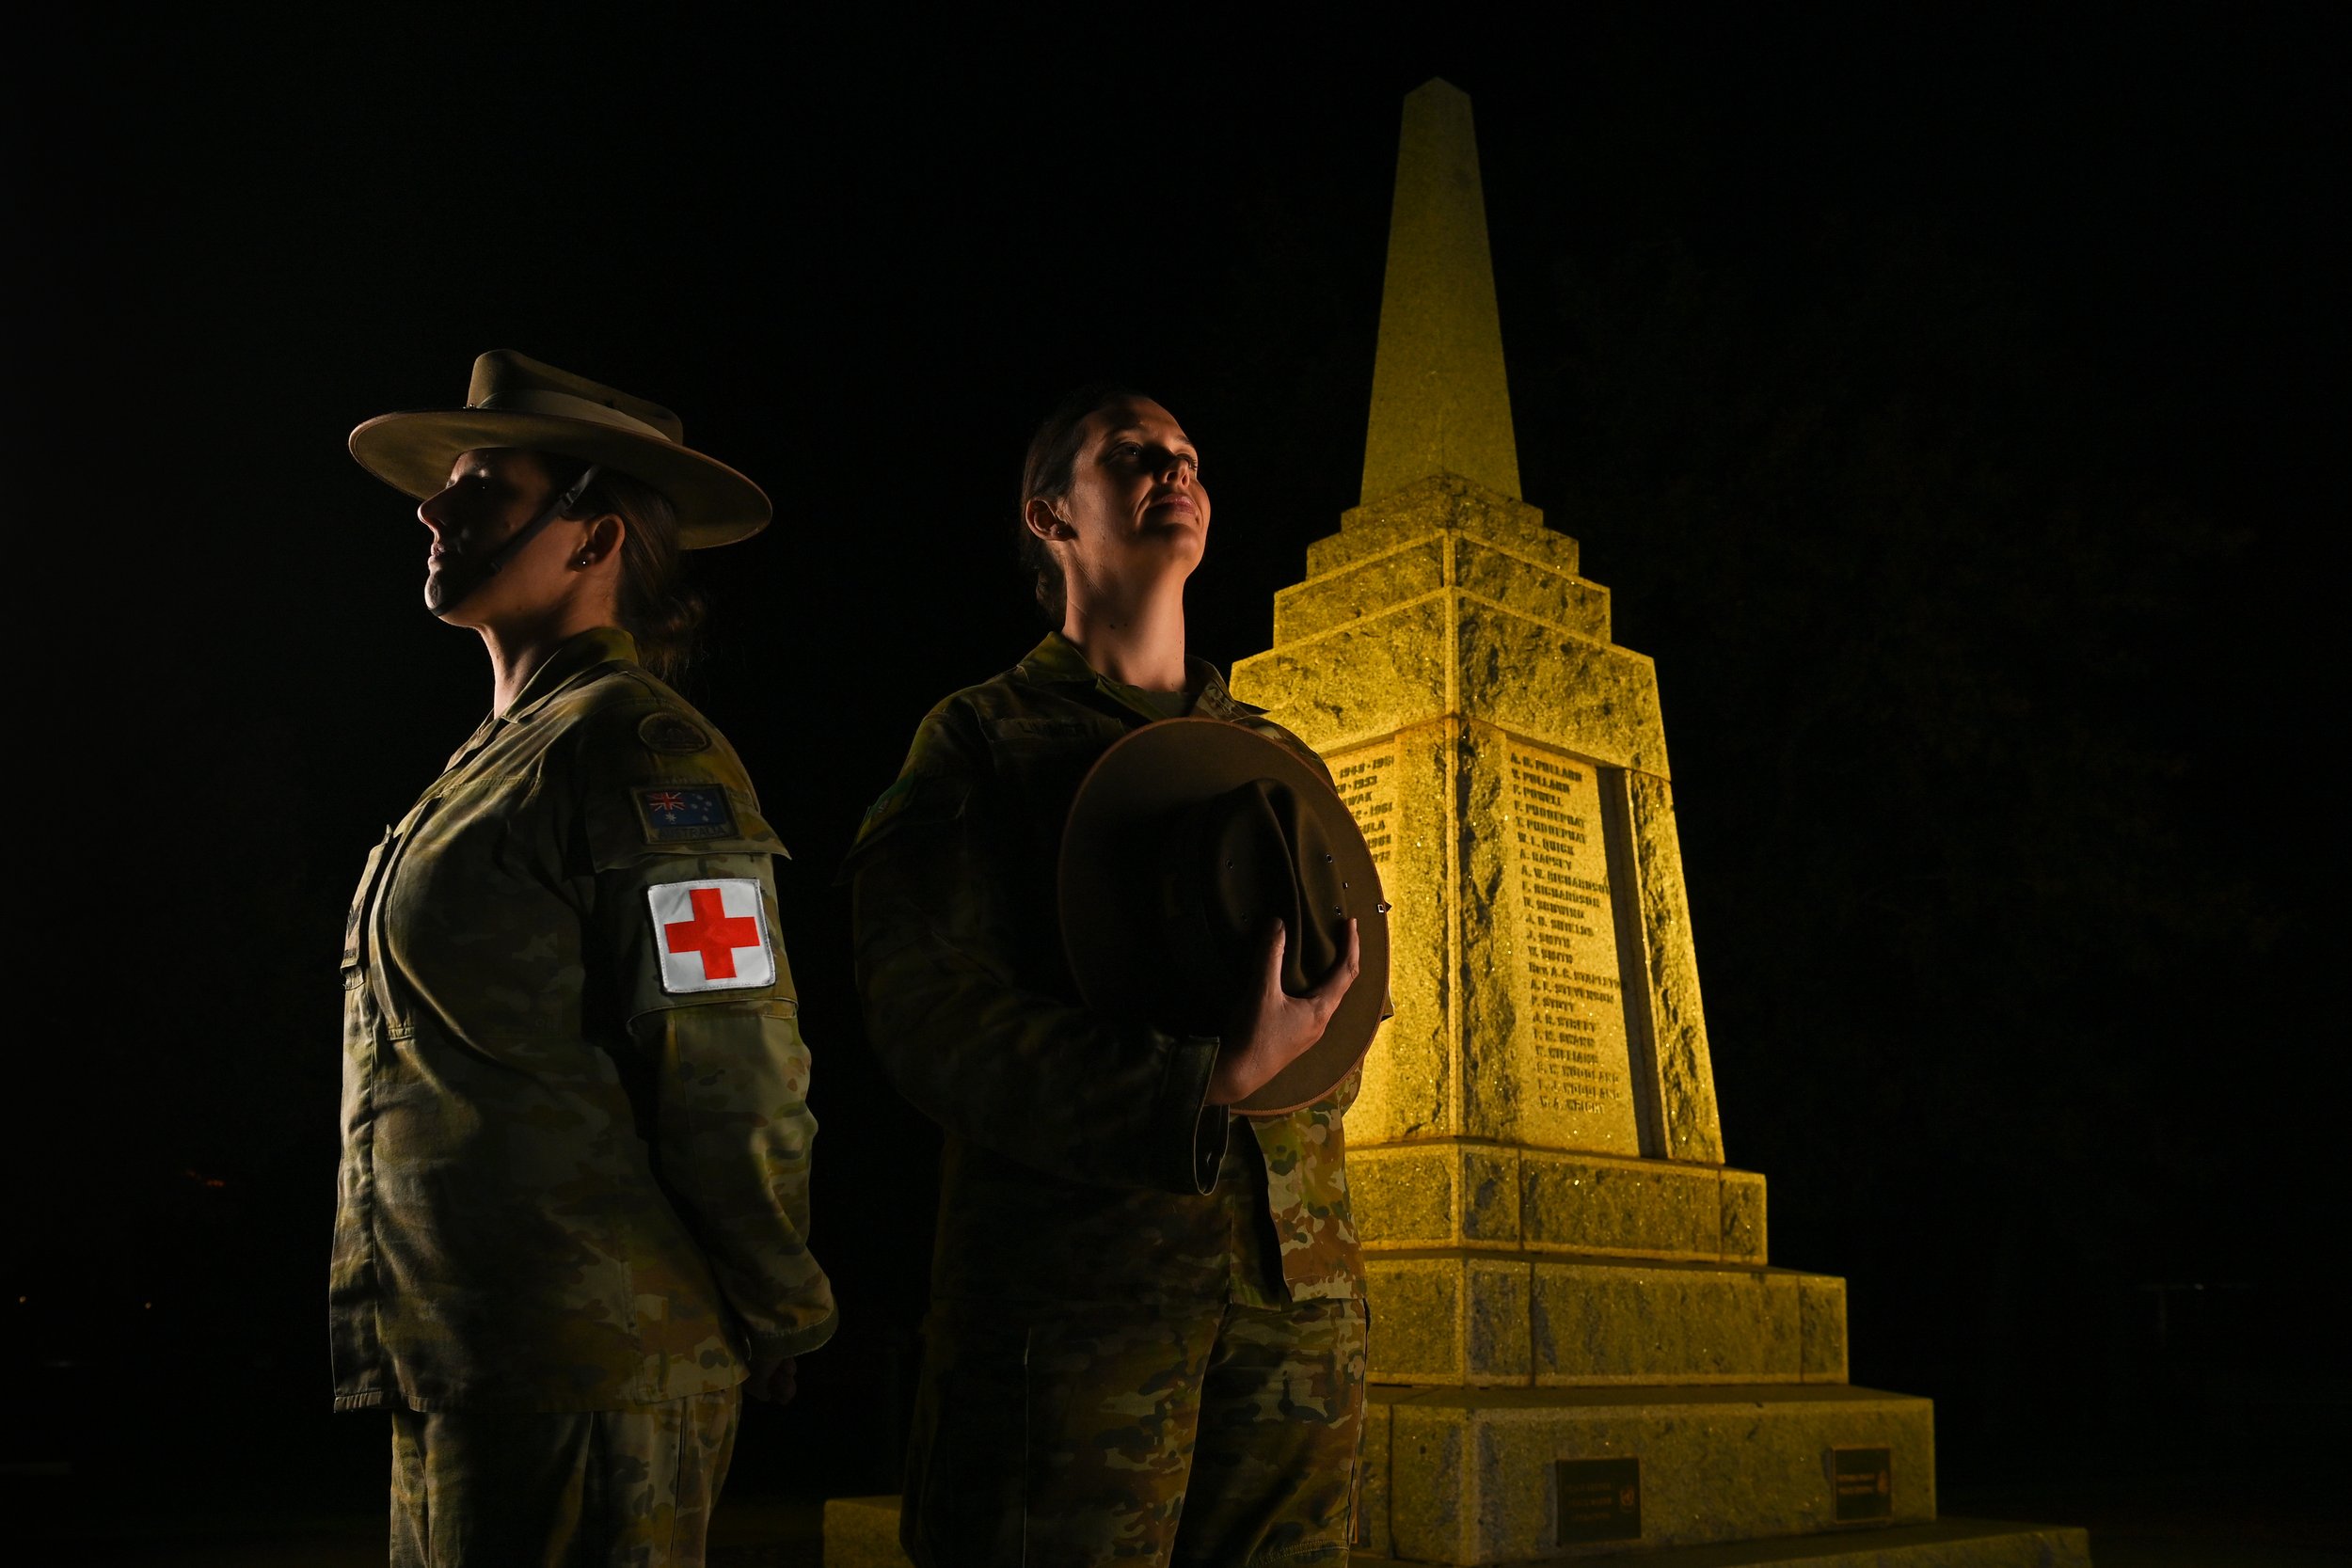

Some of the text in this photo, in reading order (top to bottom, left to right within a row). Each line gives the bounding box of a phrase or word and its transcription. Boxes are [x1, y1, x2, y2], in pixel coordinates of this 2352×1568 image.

[1535, 759, 1582, 782] POLLARD
[1523, 772, 1570, 794] POLLARD
[1523, 786, 1564, 806] POWELL
[662, 826, 725, 839] AUSTRALIA
[1542, 838, 1575, 856] QUICK
[1534, 883, 1600, 908] RICHARDSON
[1538, 932, 1570, 948] SMITH
[1541, 948, 1574, 964] SMITH
